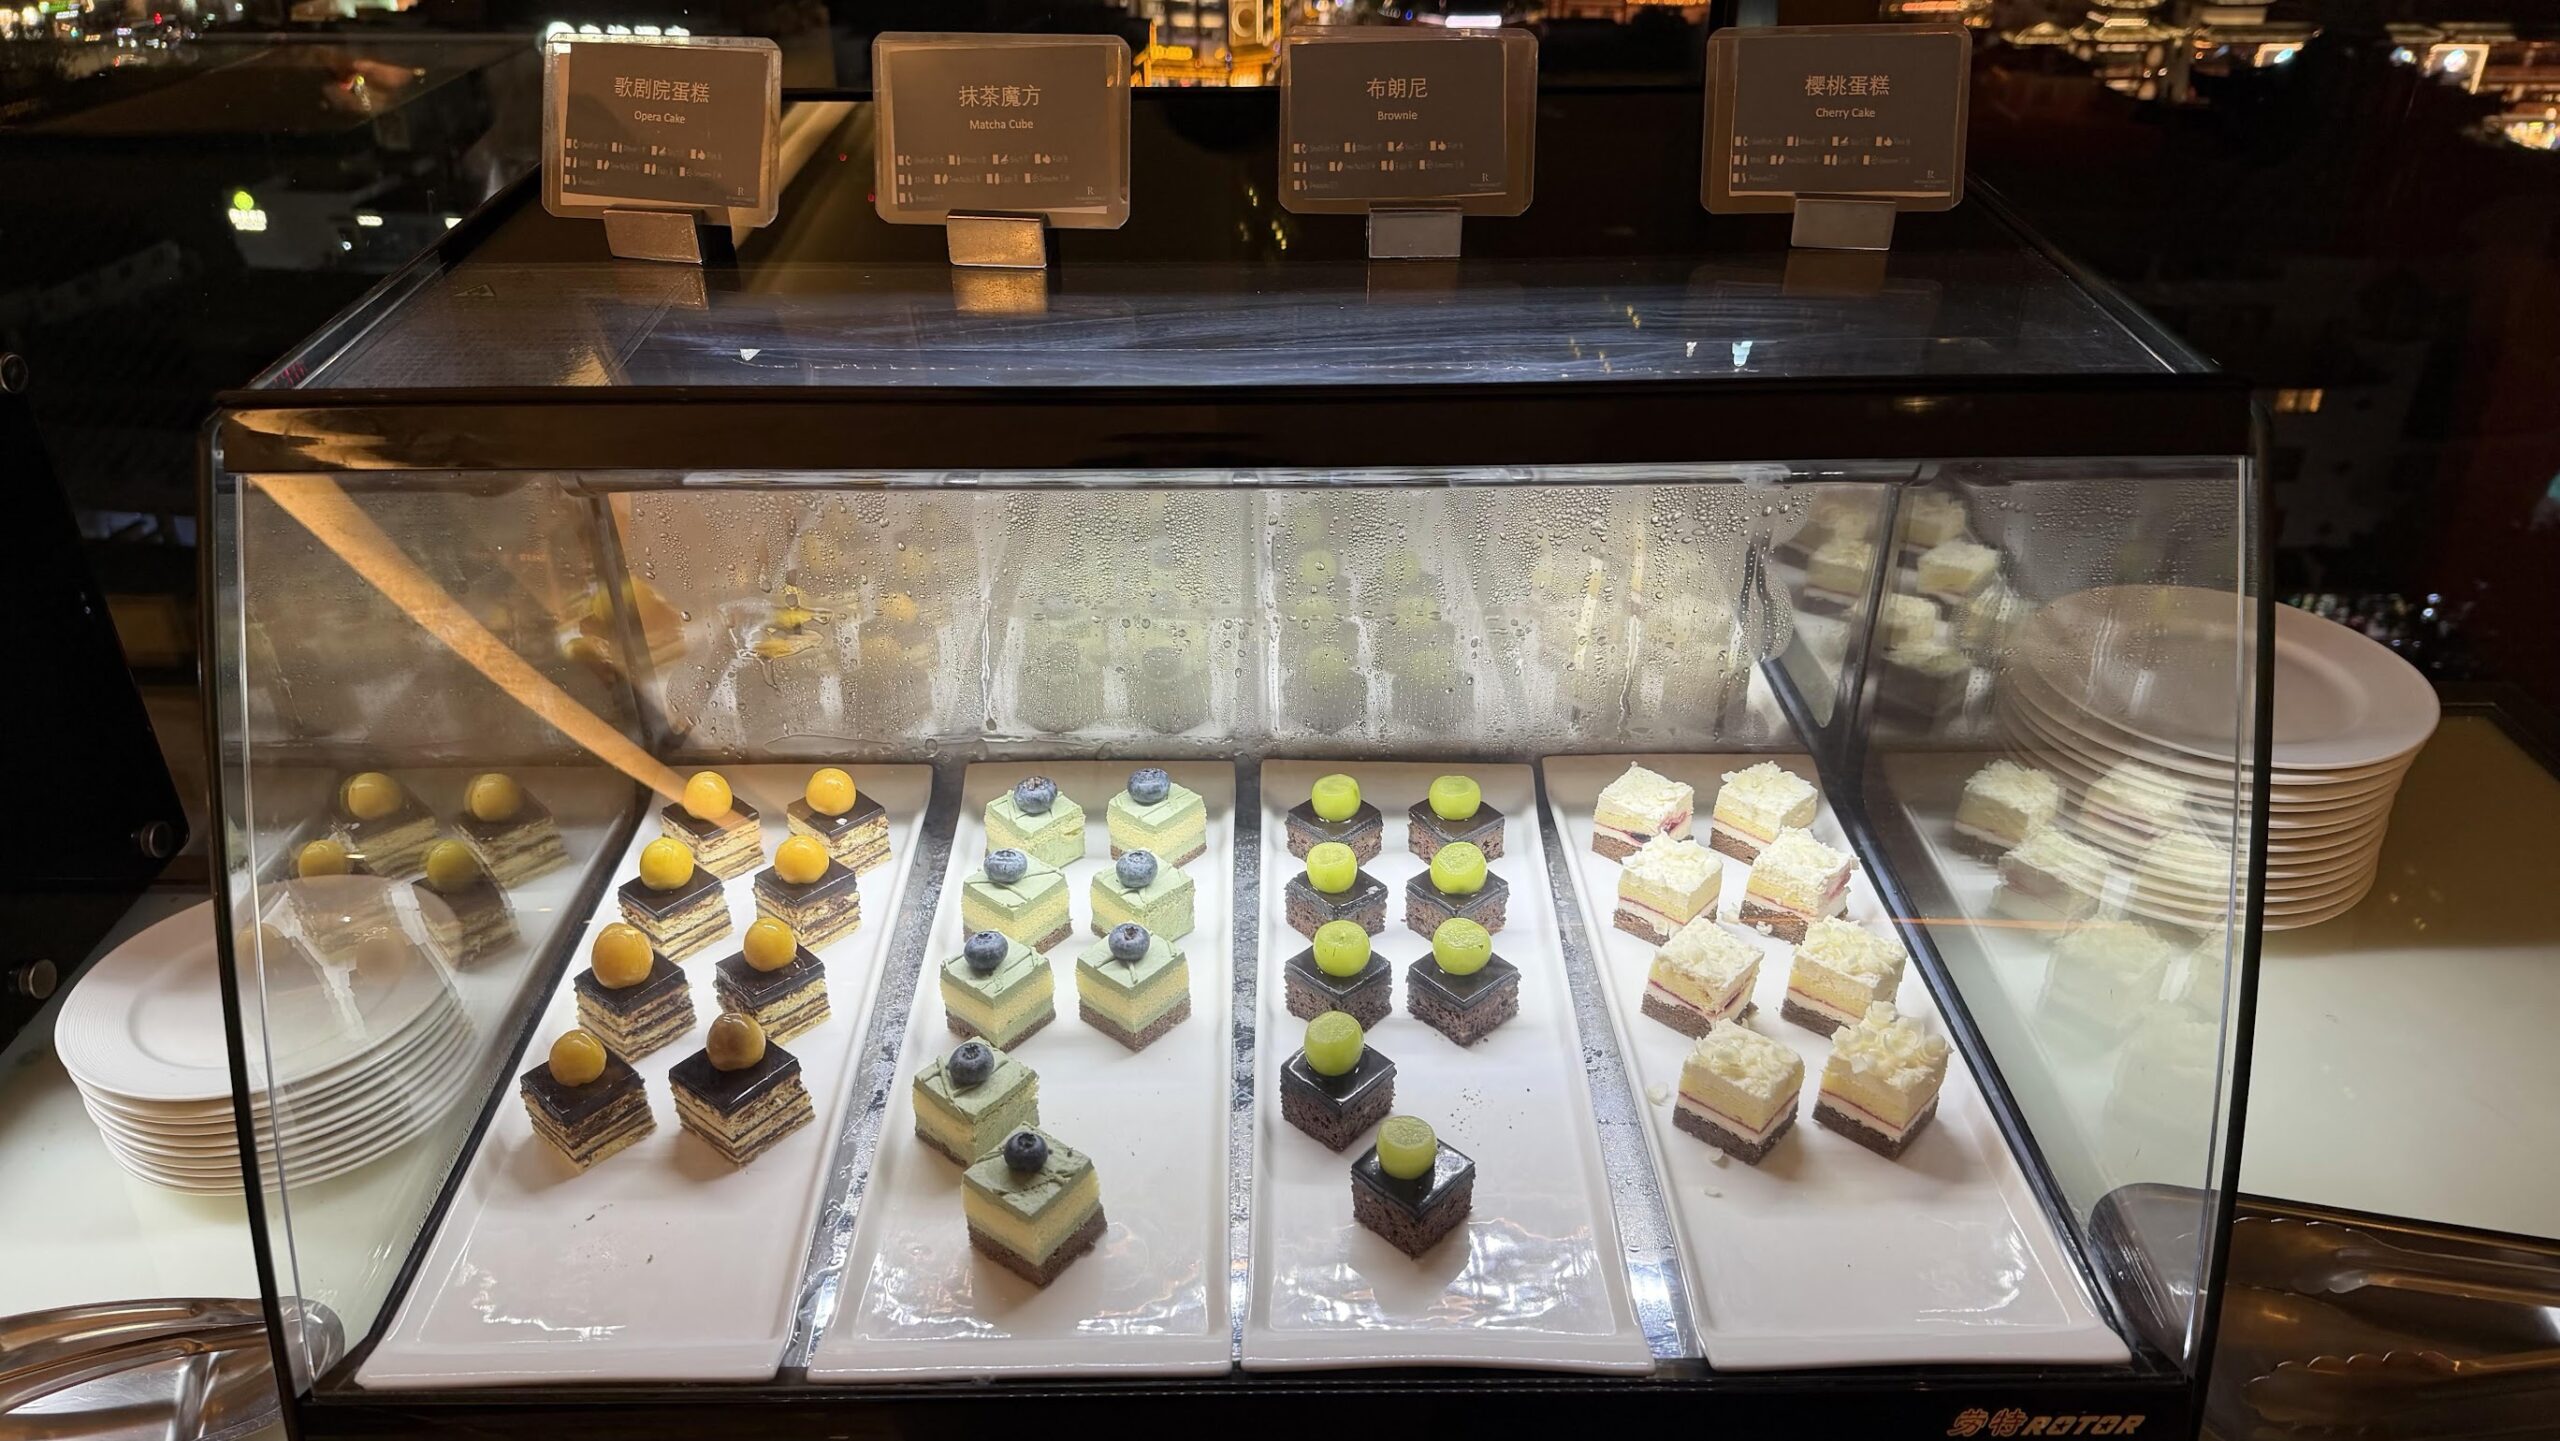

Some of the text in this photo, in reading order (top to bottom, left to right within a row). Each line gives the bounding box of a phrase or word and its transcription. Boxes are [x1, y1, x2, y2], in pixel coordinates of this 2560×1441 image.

[614, 77, 710, 103] 歌剧院蛋糕
[1366, 77, 1428, 99] 布朗尼
[1804, 75, 1890, 96] 樱桃蛋糕
[959, 85, 1041, 108] 抹茶魔方
[634, 110, 686, 124] Opera Cake
[1377, 110, 1418, 120] Brownie
[1815, 107, 1876, 120] Cherry Cake
[969, 119, 1034, 130] Matcha Cube
[2020, 1415, 2146, 1436] ROTOR
